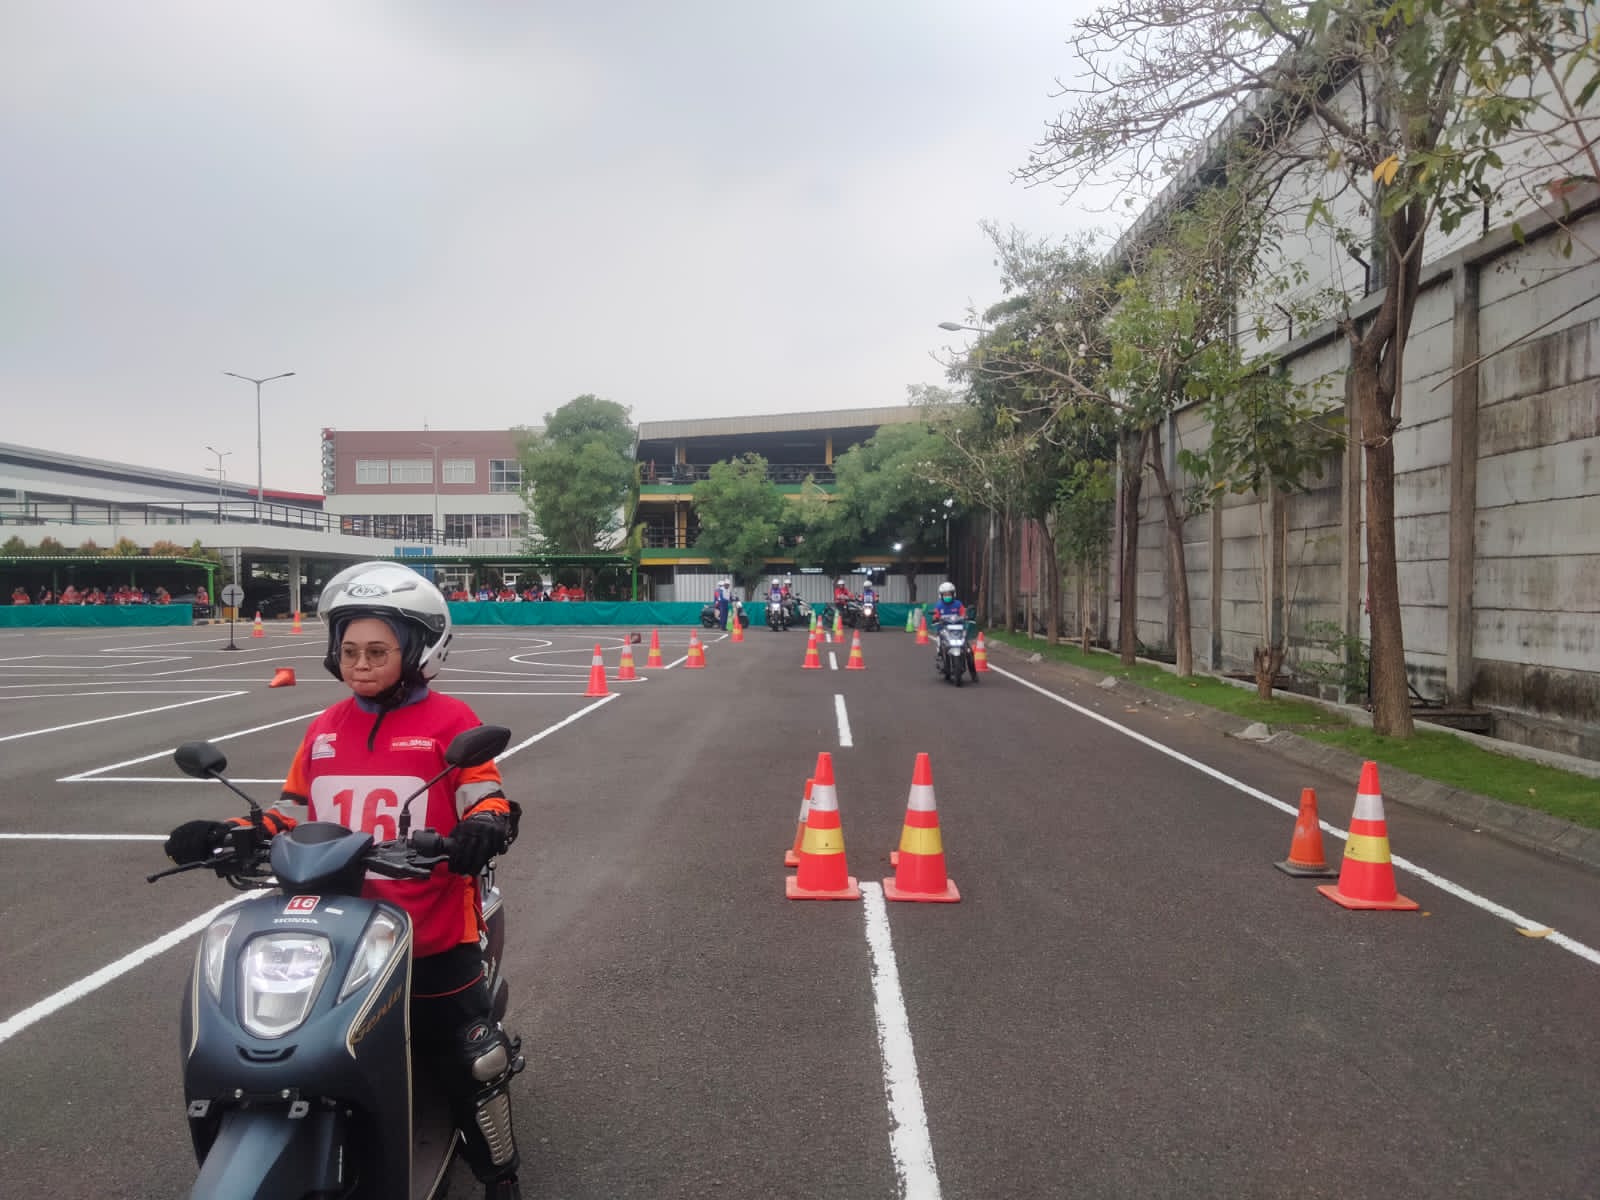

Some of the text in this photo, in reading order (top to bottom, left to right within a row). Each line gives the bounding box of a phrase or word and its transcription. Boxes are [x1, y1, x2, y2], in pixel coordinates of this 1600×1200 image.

[333, 788, 398, 843] 16
[291, 898, 316, 909] 16
[273, 917, 319, 925] HONDA
